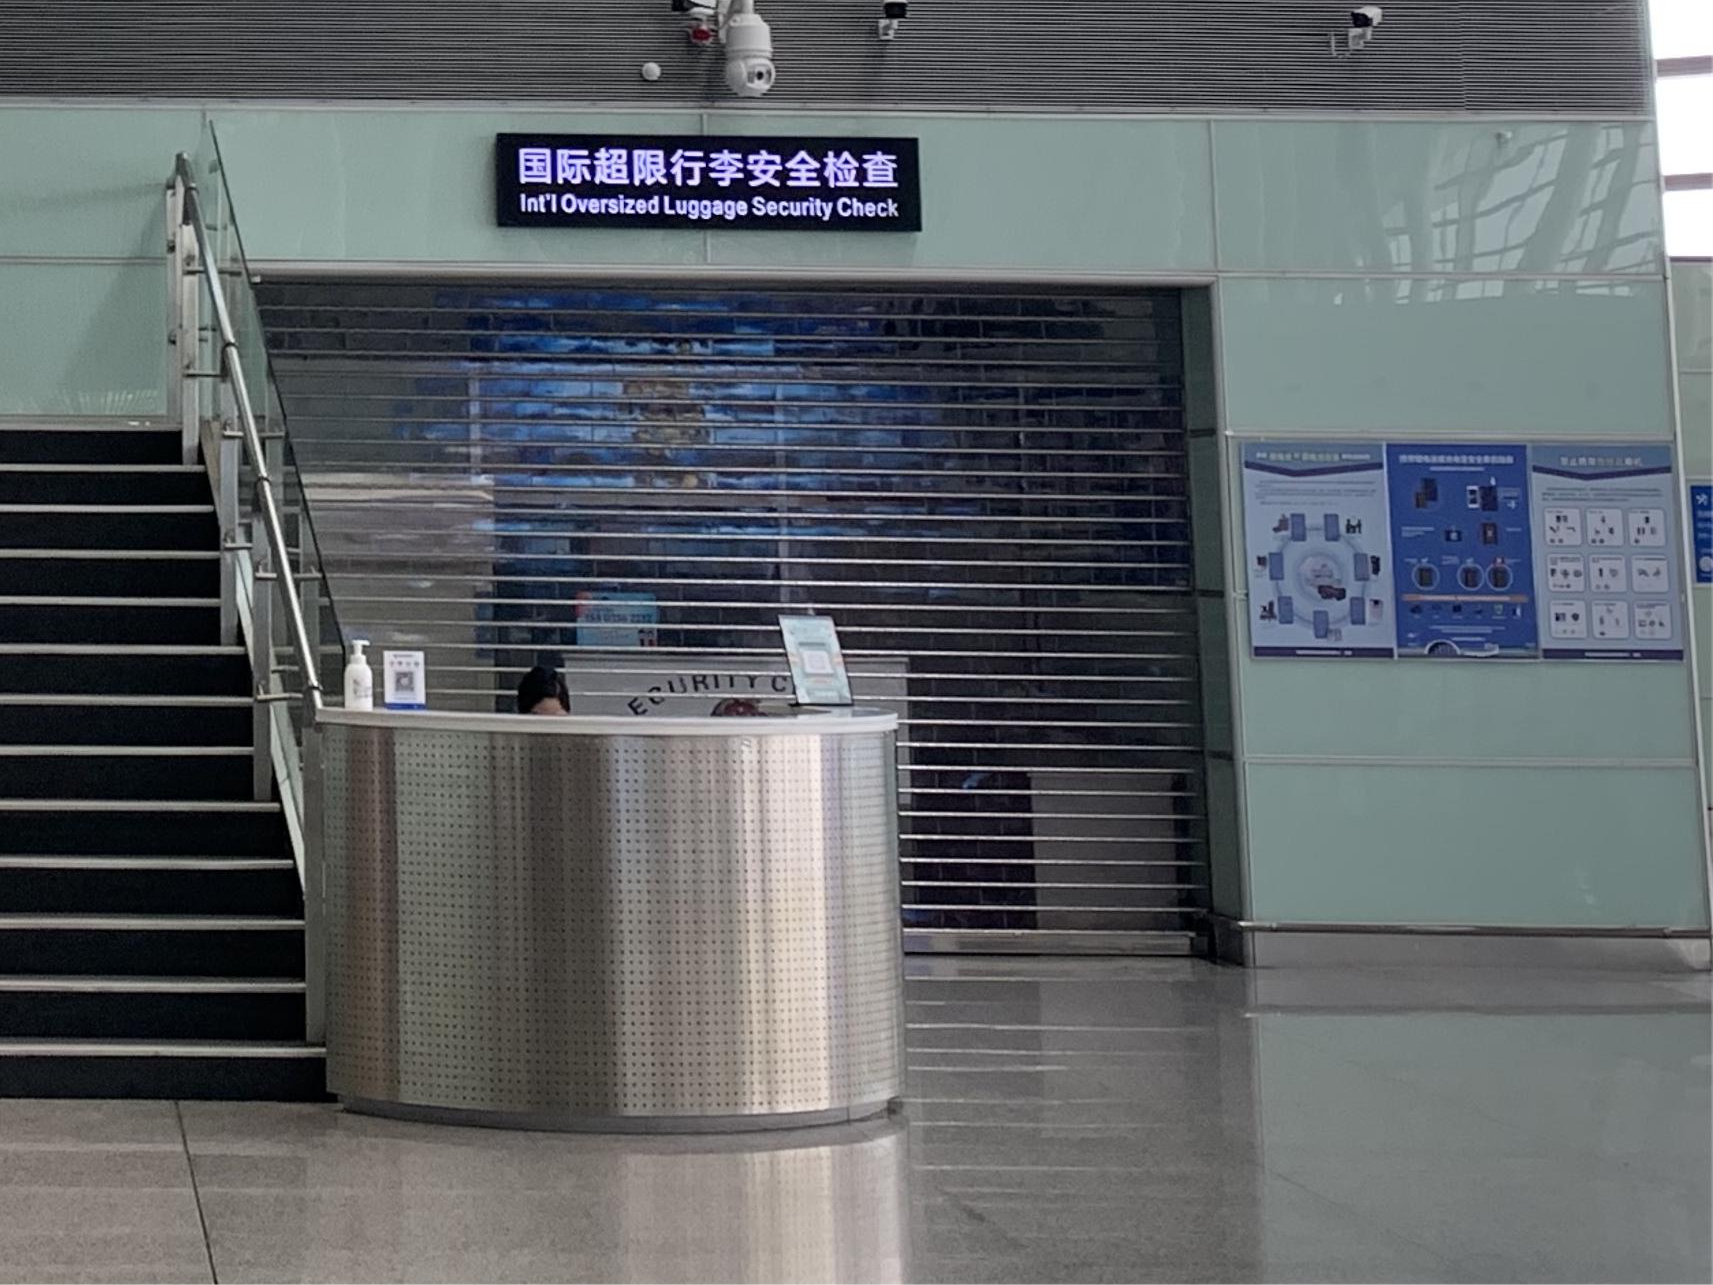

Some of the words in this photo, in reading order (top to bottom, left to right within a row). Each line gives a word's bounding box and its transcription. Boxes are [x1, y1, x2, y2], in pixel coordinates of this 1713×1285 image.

[518, 147, 899, 189] 国际超限行李安全检查
[561, 194, 659, 215] Oversized
[663, 196, 748, 220] Luggage
[752, 197, 833, 221] Security
[837, 197, 900, 218] Check
